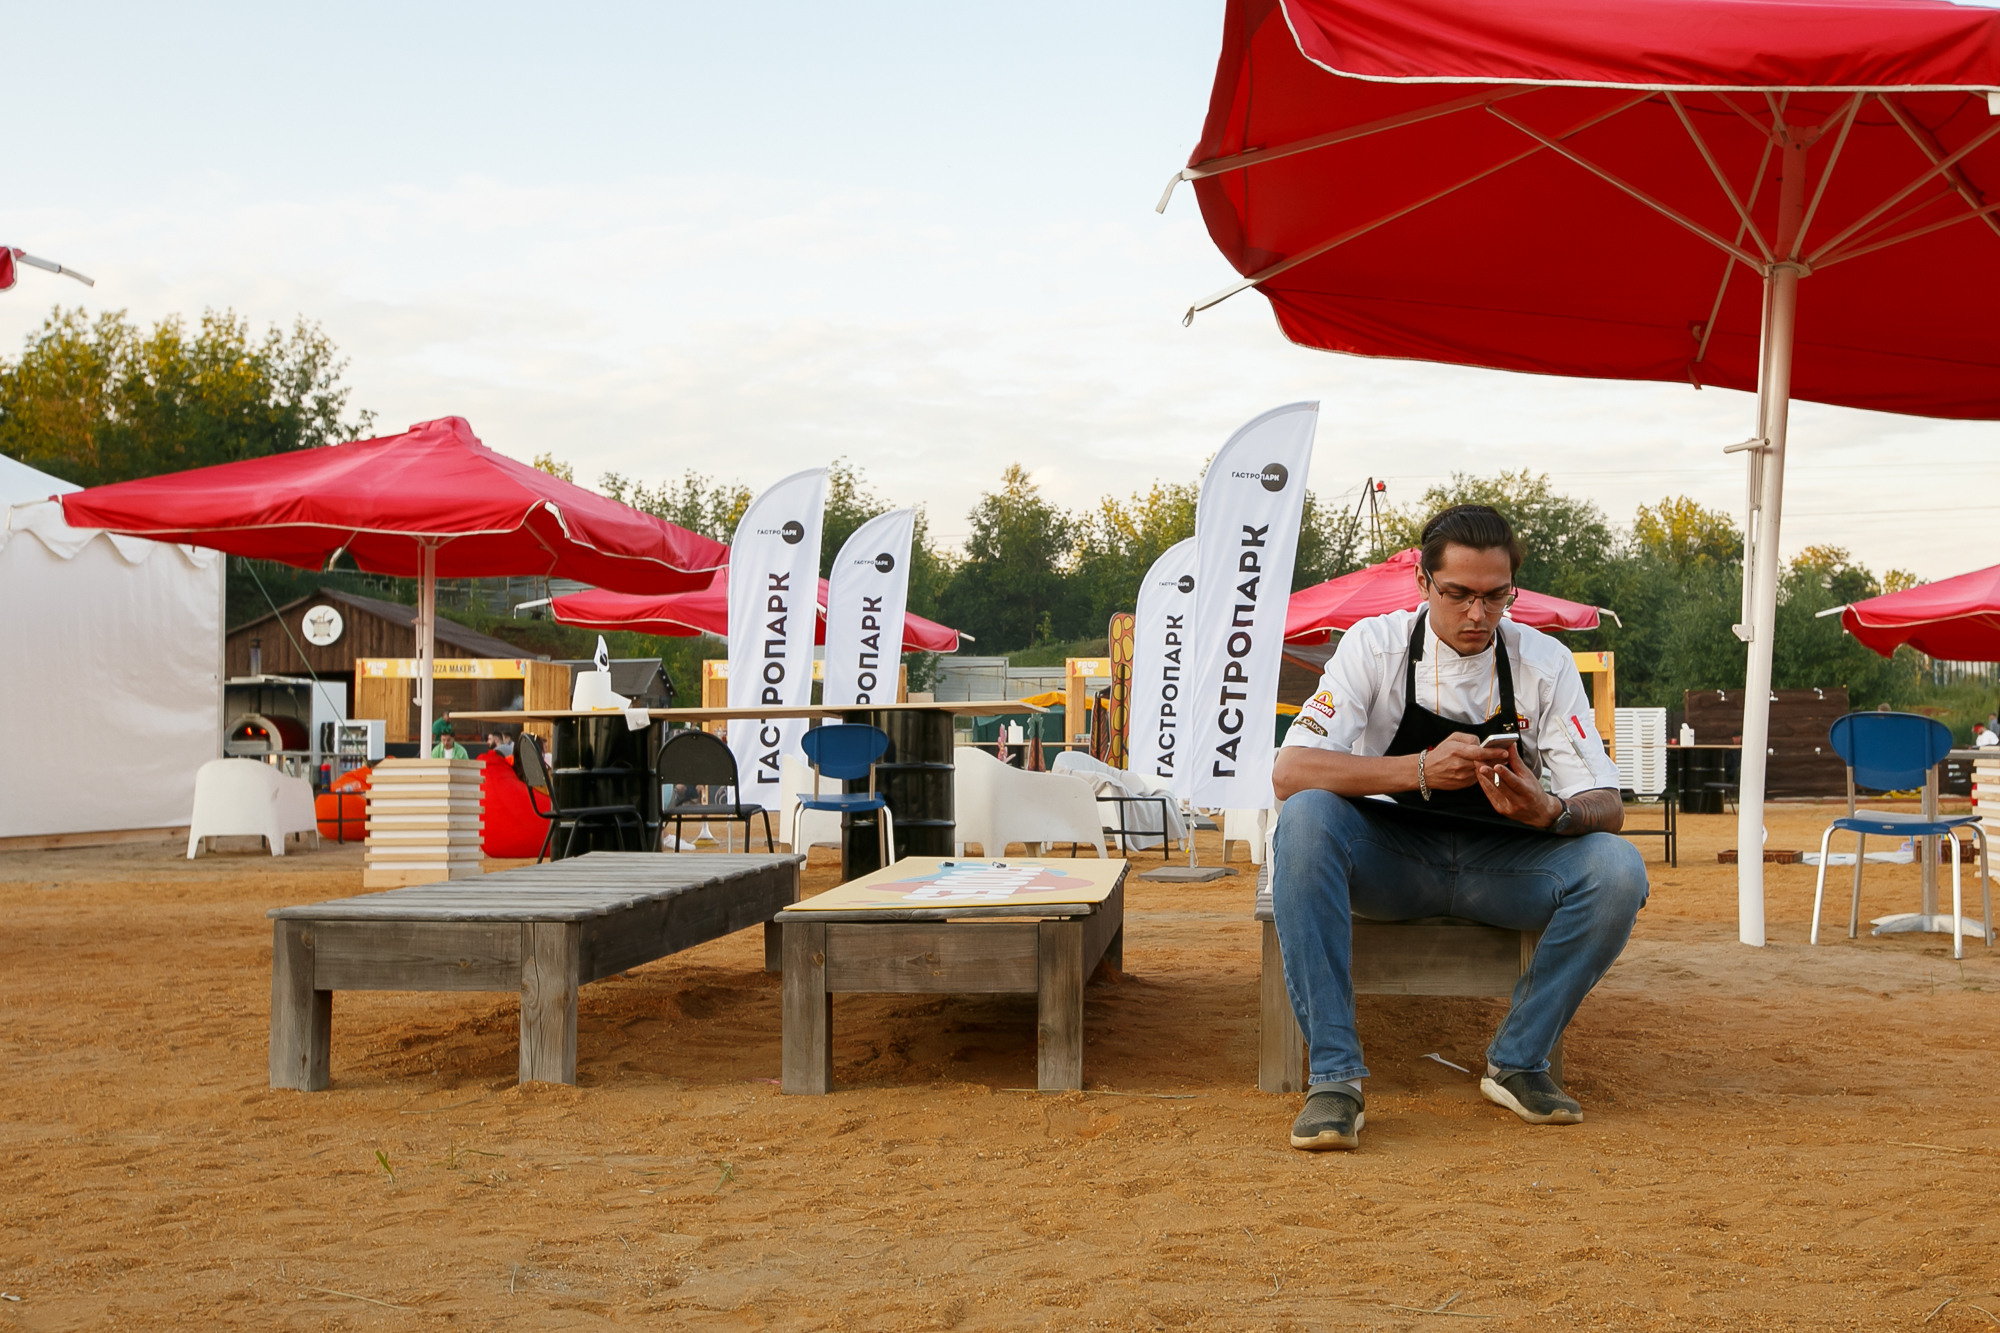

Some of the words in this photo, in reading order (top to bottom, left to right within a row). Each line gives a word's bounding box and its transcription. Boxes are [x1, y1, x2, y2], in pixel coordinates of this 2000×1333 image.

[757, 571, 790, 784] ГАСРОПАРК
[1156, 613, 1184, 778] ГАСТРОПАРК
[1212, 523, 1270, 778] ГАСТРОПАРК
